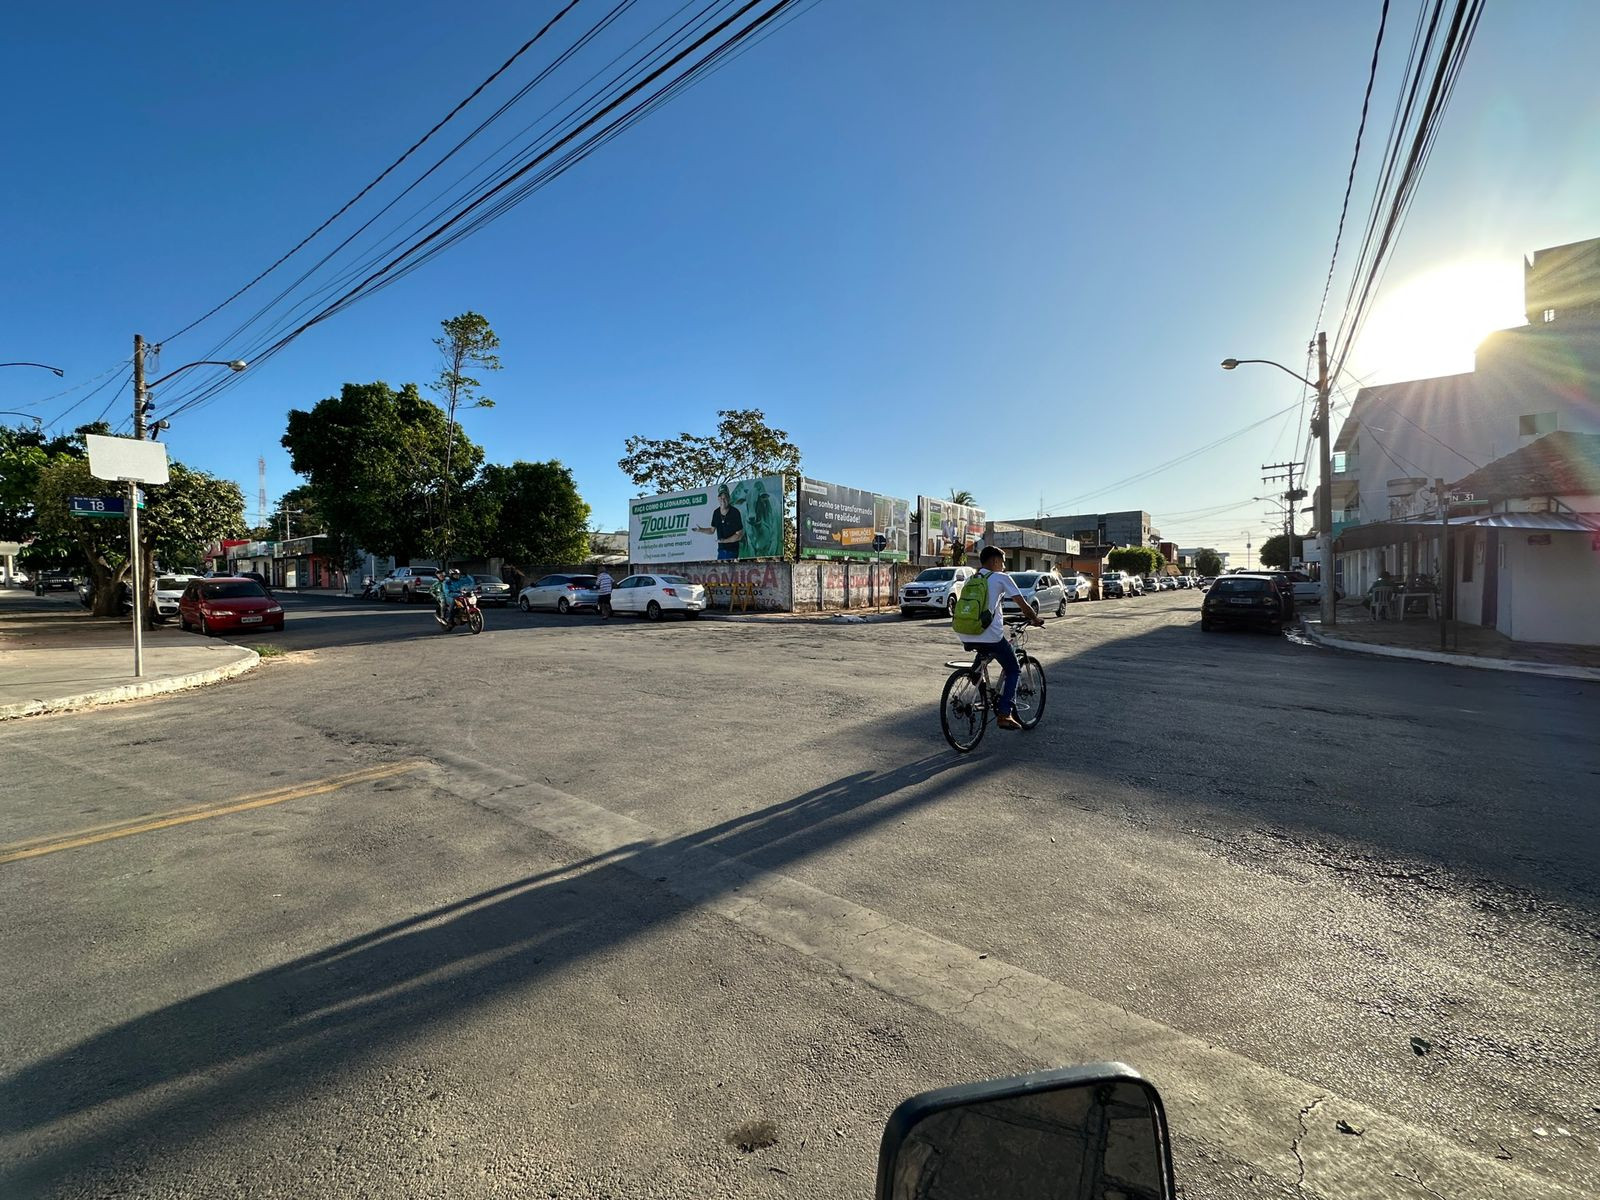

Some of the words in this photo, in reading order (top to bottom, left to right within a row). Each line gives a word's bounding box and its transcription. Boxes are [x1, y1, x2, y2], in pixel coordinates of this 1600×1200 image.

[692, 496, 703, 504] USE
[1464, 493, 1473, 501] 31
[74, 501, 82, 510] L
[90, 501, 105, 511] 18
[808, 498, 818, 507] Um
[818, 500, 834, 509] sonho
[834, 503, 840, 511] se
[840, 504, 873, 516] transformando
[824, 511, 834, 520] em
[834, 512, 861, 524] realidade!
[811, 520, 832, 529] Residencial
